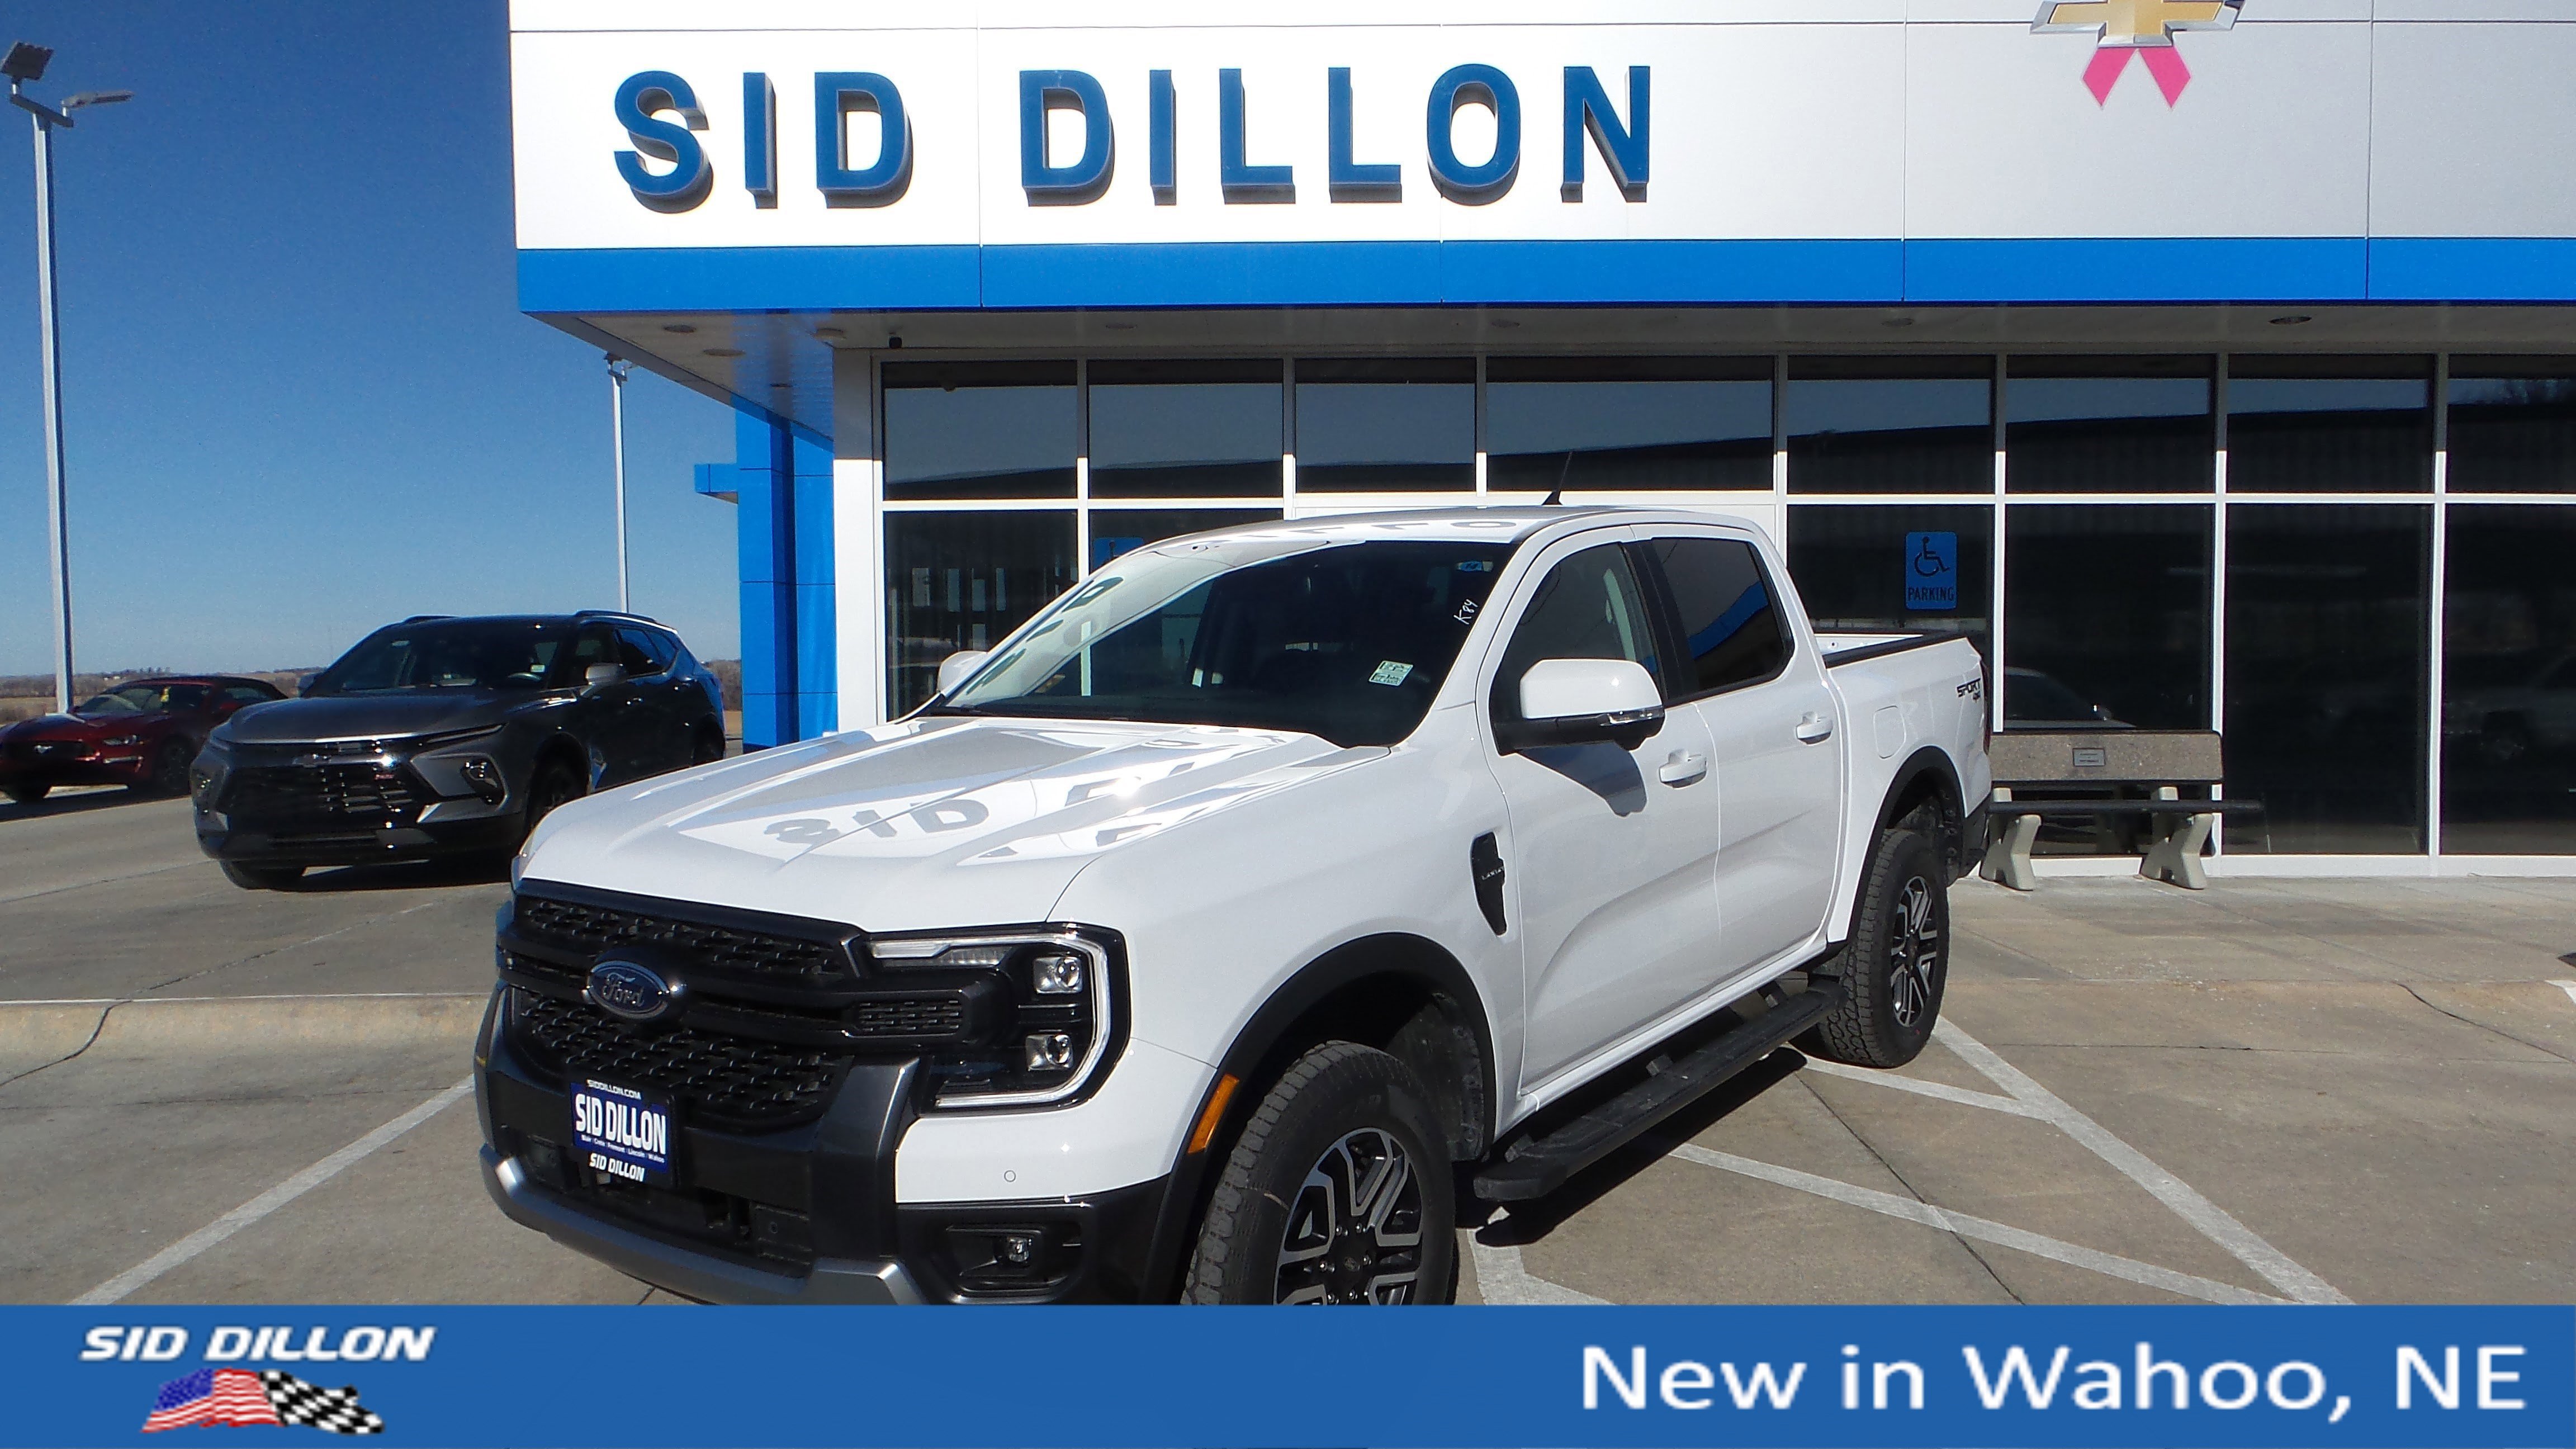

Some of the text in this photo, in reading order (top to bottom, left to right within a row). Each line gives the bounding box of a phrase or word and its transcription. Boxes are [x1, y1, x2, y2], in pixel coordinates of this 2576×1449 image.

[614, 64, 1651, 213] SID DILLON
[1907, 586, 1954, 601] PARKING
[603, 972, 645, 1007] Ford
[586, 1079, 641, 1100] SIDDILLON.COM
[575, 1093, 666, 1154] SID DILLON
[589, 1152, 645, 1182] SID DILLON
